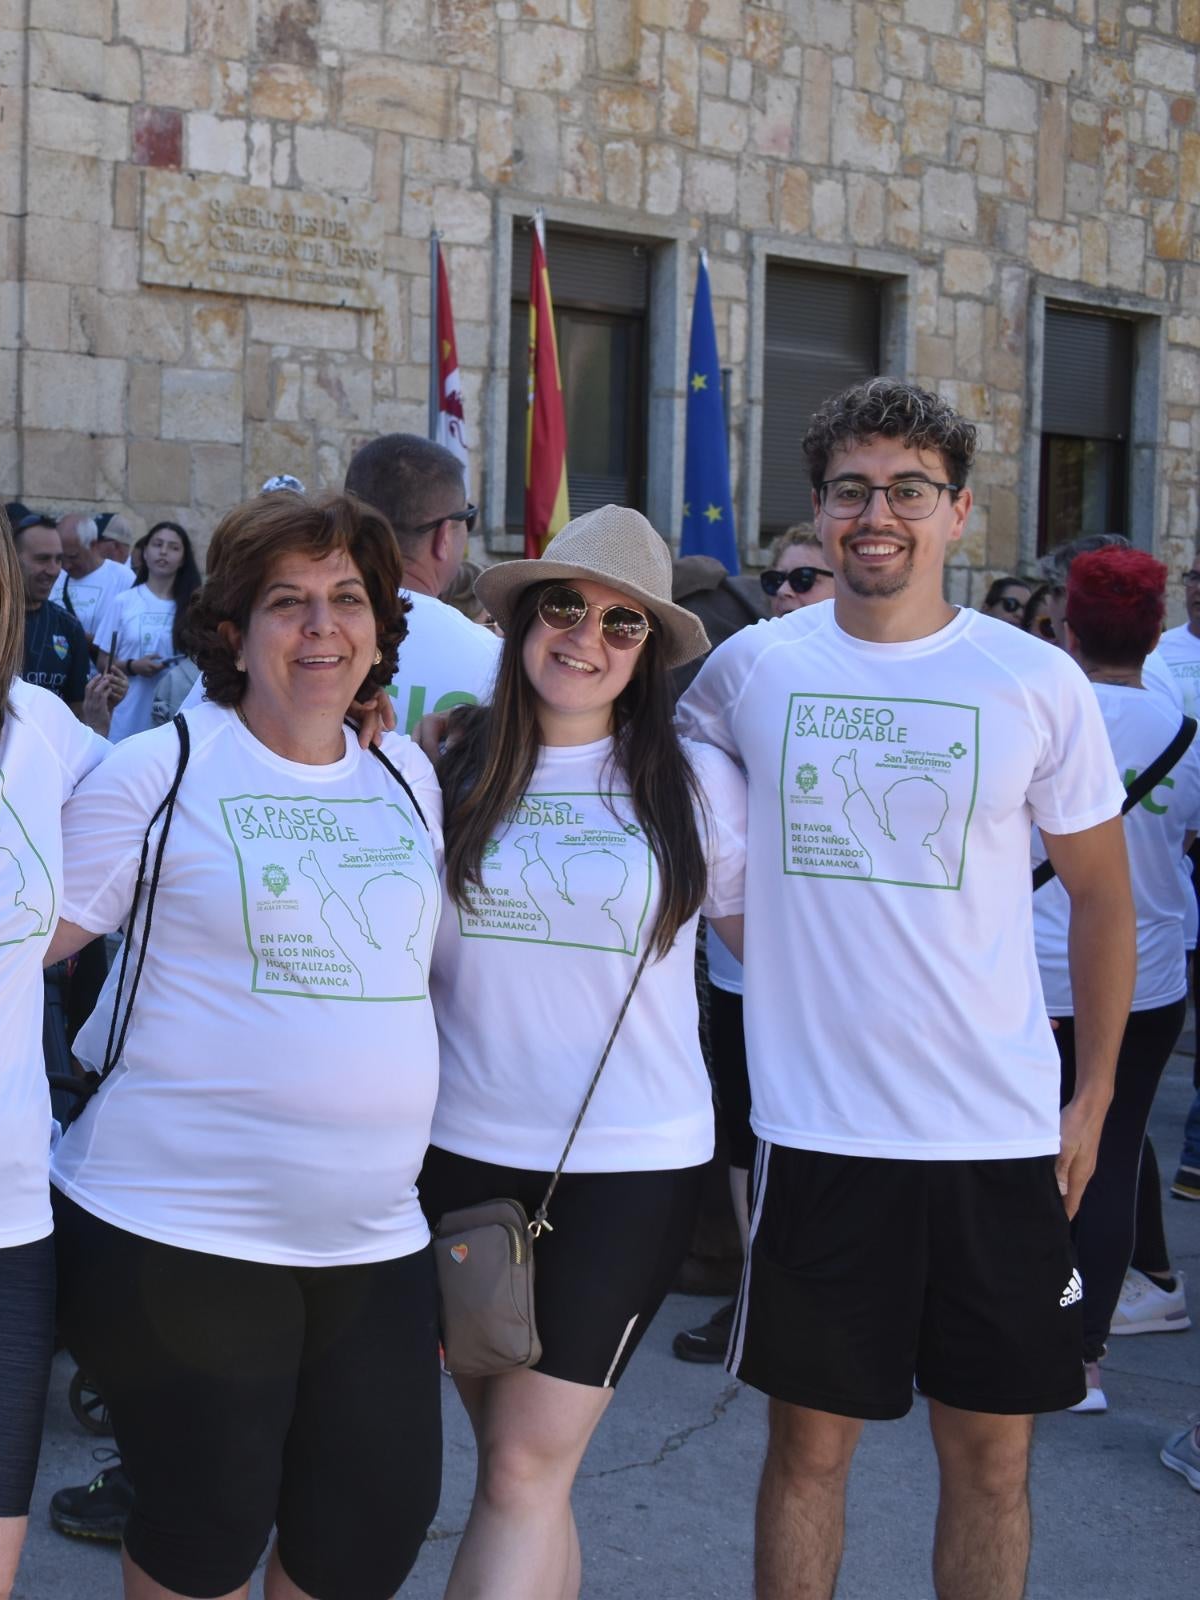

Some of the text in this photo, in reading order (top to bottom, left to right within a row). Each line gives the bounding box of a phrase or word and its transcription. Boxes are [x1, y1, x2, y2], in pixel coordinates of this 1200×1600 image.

[796, 705, 894, 726] IX PASEO
[794, 722, 908, 743] SALUDABLE
[883, 753, 902, 763] San
[517, 798, 572, 811] ASEO
[235, 806, 337, 826] IX PASEO
[241, 824, 359, 843] SALUDABLE
[804, 824, 832, 832] FAVOR
[821, 834, 849, 846] NIÑOS
[343, 854, 362, 862] San
[792, 846, 864, 858] HOSPITALIZADOS
[804, 858, 859, 869] SALAMANCA
[498, 898, 527, 908] NIÑOS
[481, 920, 537, 931] SALAMANCA
[260, 934, 313, 943] EN FAVOR
[262, 946, 335, 959] DE LOS NIÑOS
[267, 960, 352, 973] HOSPITALIZADOS
[265, 972, 350, 987] EN SALAMANCA
